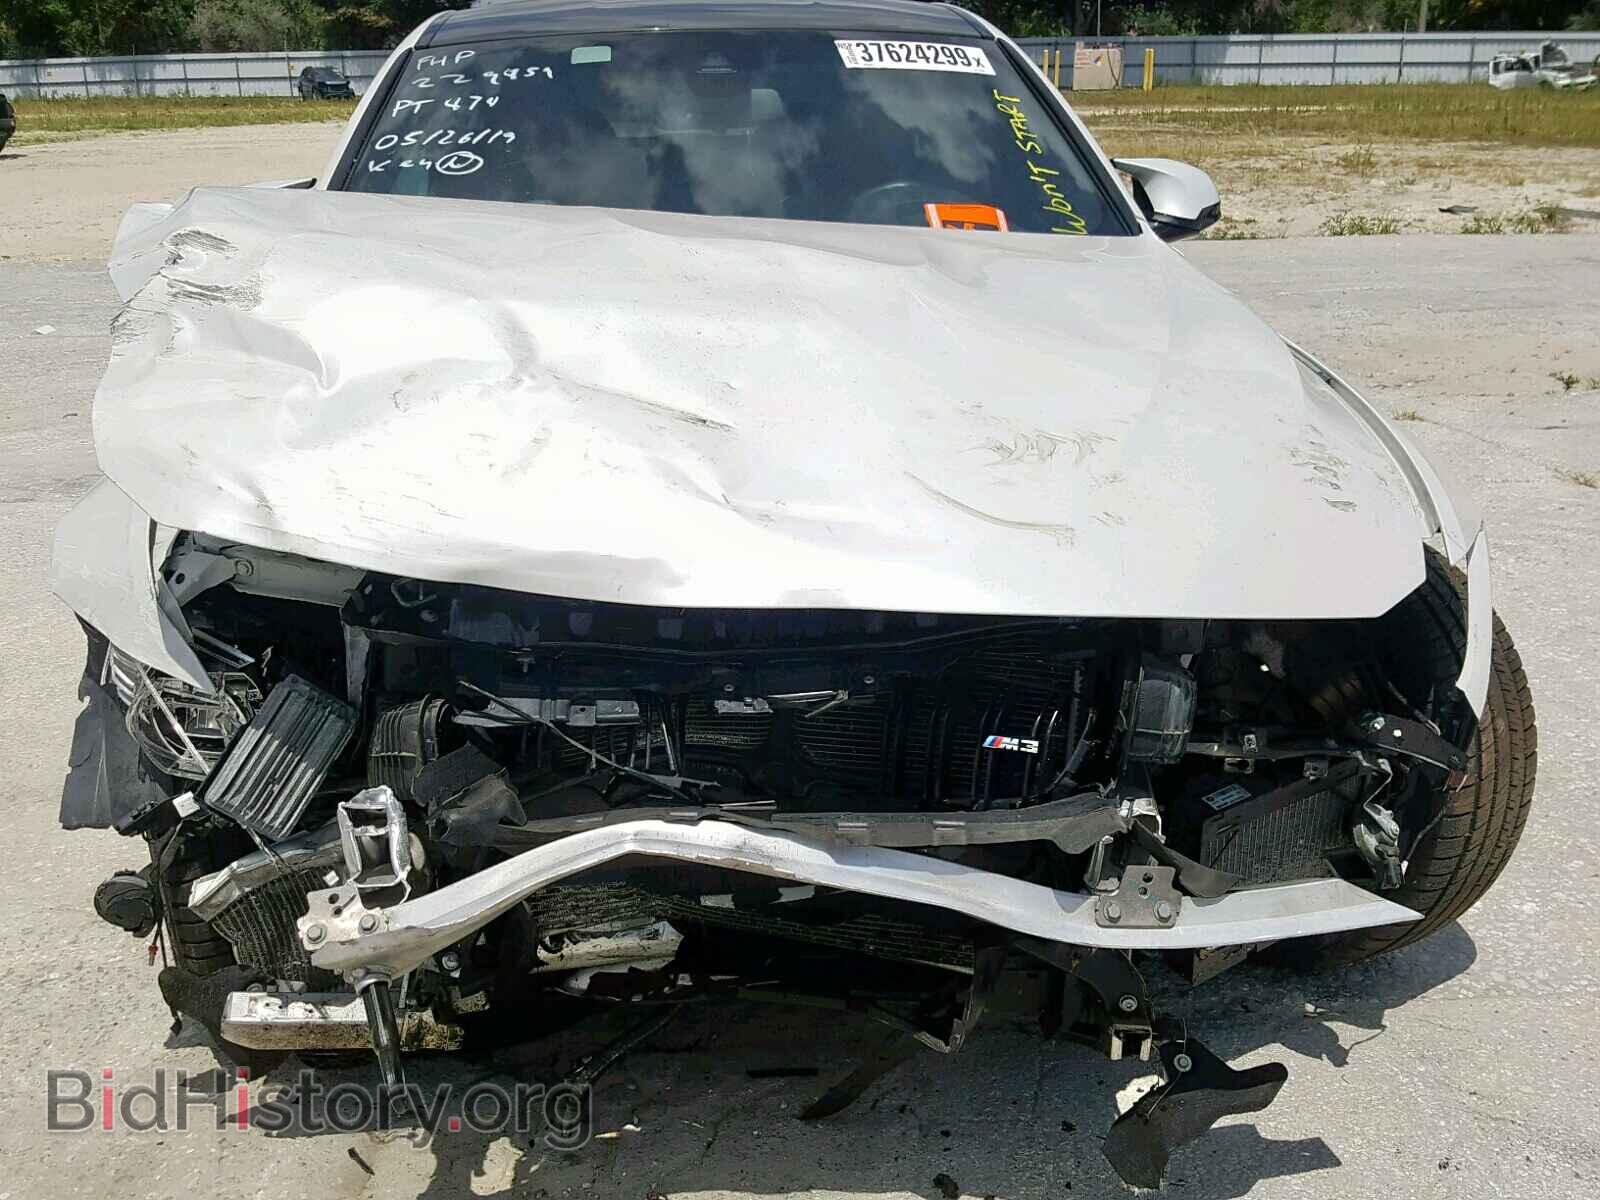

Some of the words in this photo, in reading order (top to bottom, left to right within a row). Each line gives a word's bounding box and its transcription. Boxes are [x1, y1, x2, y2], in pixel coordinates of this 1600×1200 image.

[856, 42, 972, 66] 37624299
[993, 89, 1042, 154] START
[1001, 737, 1039, 753] M3
